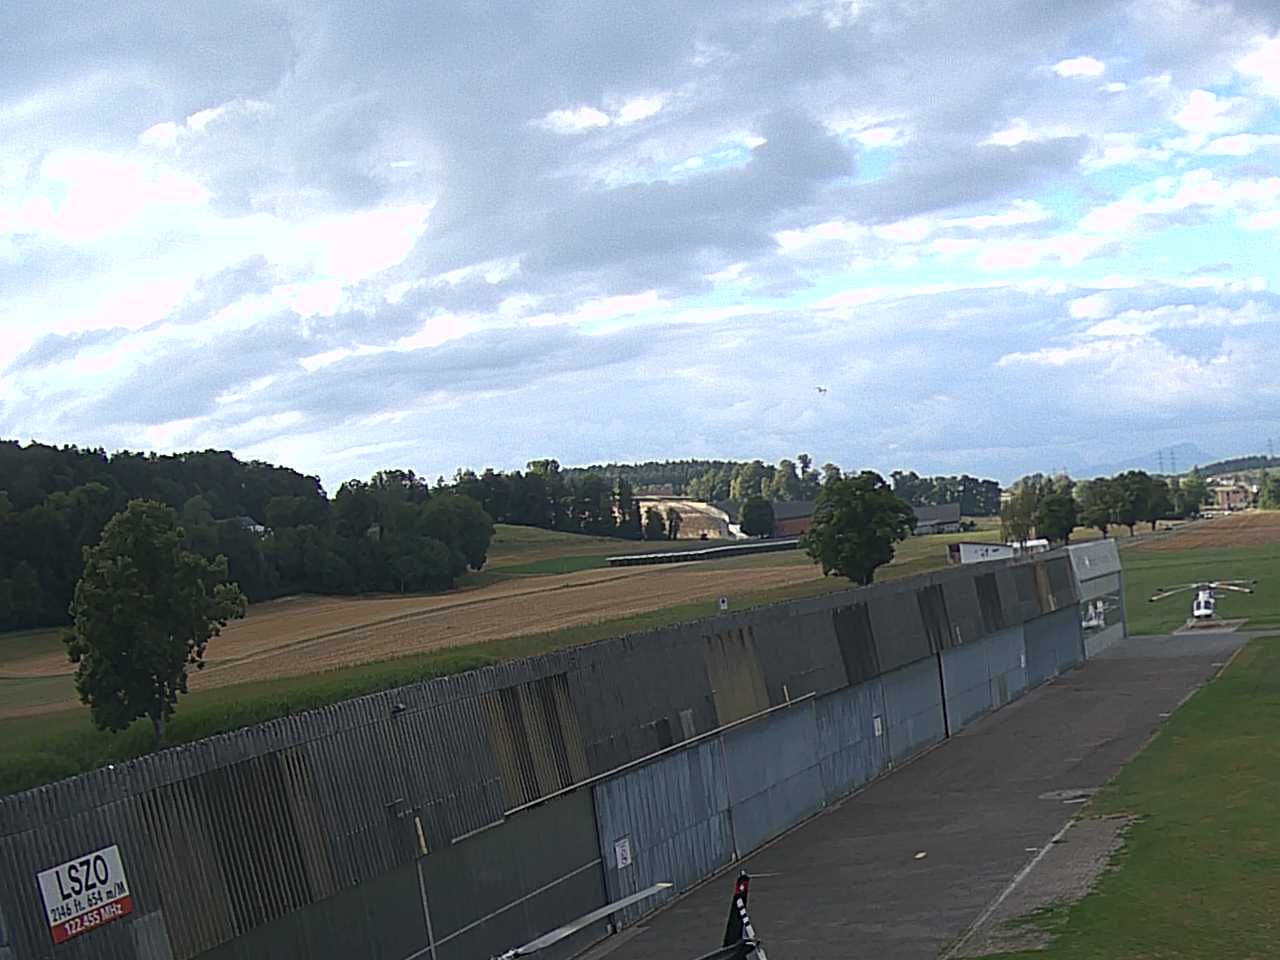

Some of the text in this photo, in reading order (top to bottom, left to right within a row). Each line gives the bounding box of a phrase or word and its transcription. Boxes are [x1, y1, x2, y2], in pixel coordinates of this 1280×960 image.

[55, 856, 108, 900] LSZO
[51, 905, 72, 922] 2146
[64, 902, 123, 936] 122.455 MHz
